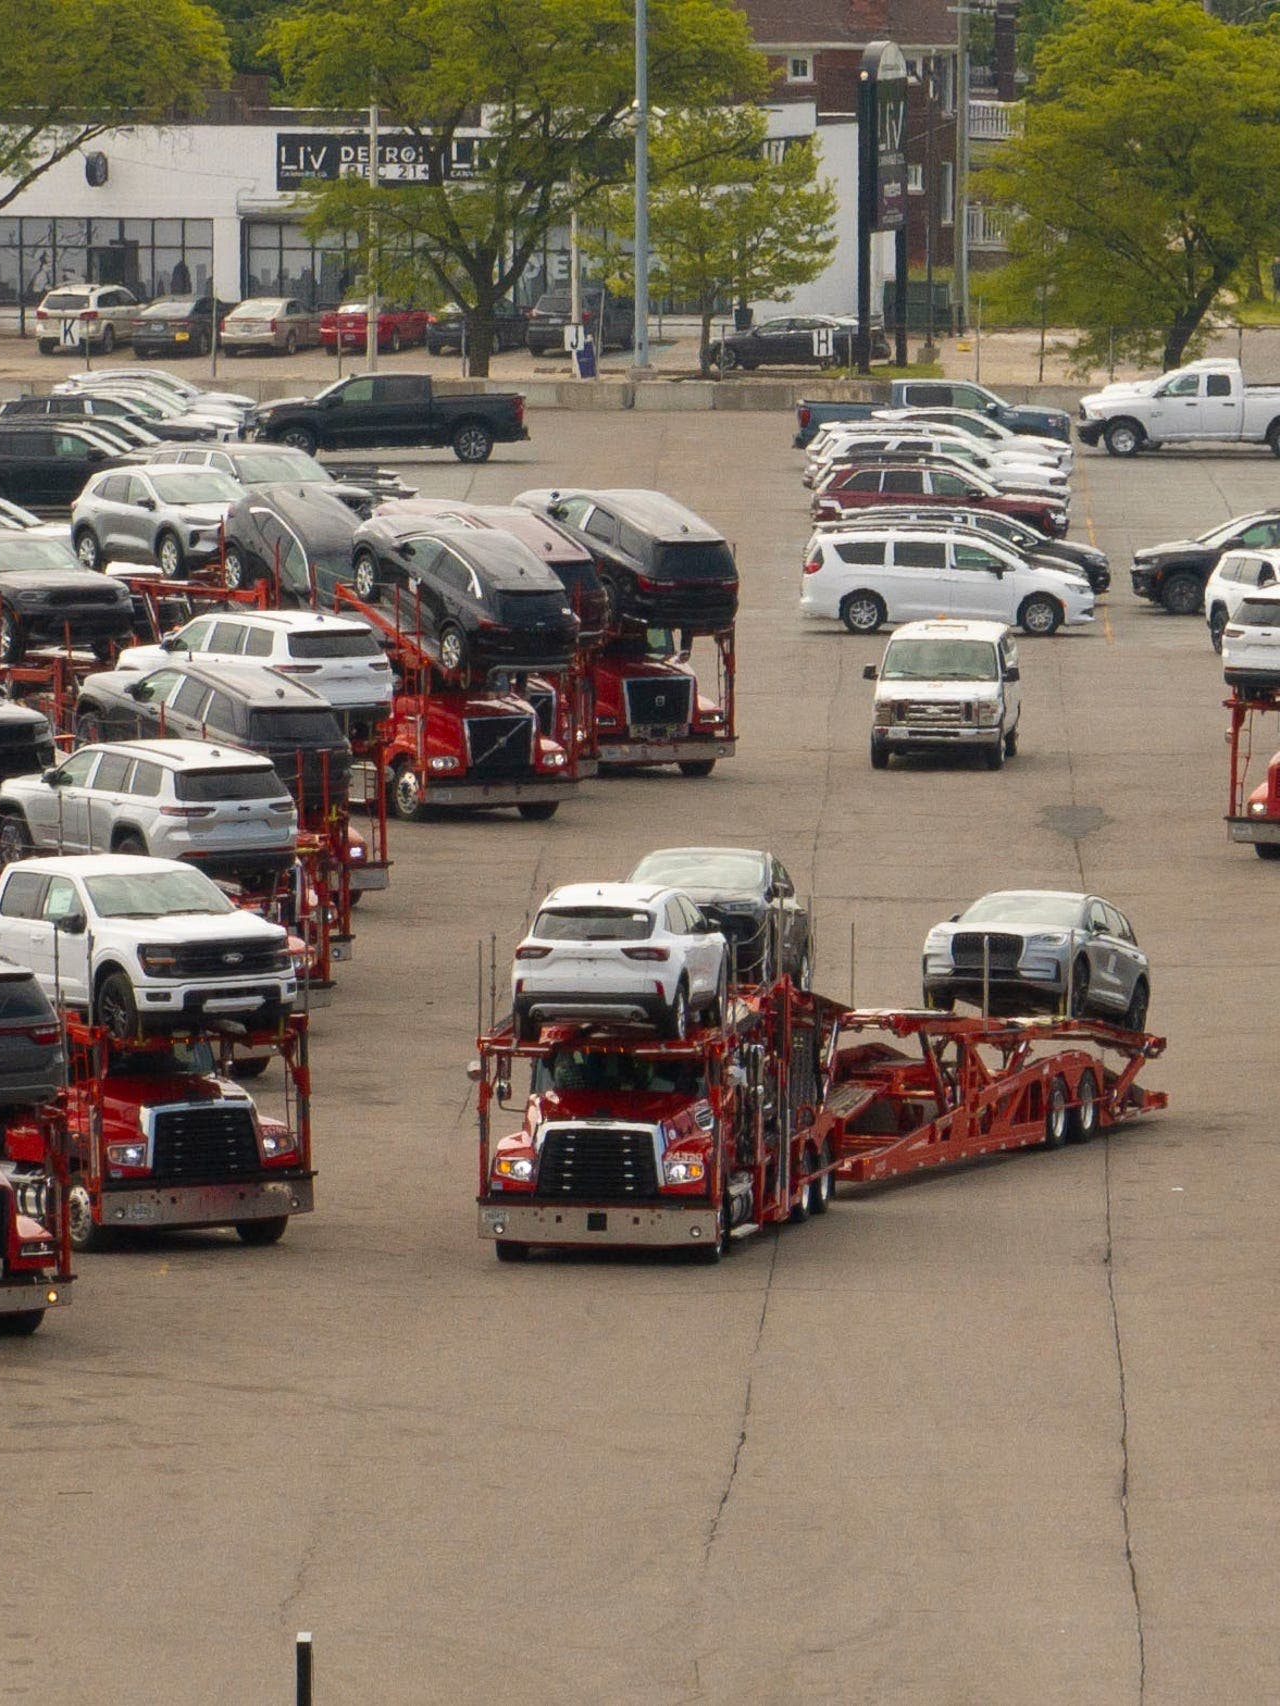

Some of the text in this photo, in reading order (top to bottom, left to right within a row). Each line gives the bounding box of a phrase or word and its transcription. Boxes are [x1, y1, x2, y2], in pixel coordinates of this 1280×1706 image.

[281, 146, 327, 170] LIV
[340, 146, 435, 163] DETROI
[399, 164, 429, 179] 21+
[63, 318, 76, 345] K
[570, 325, 579, 350] J
[817, 328, 830, 356] H
